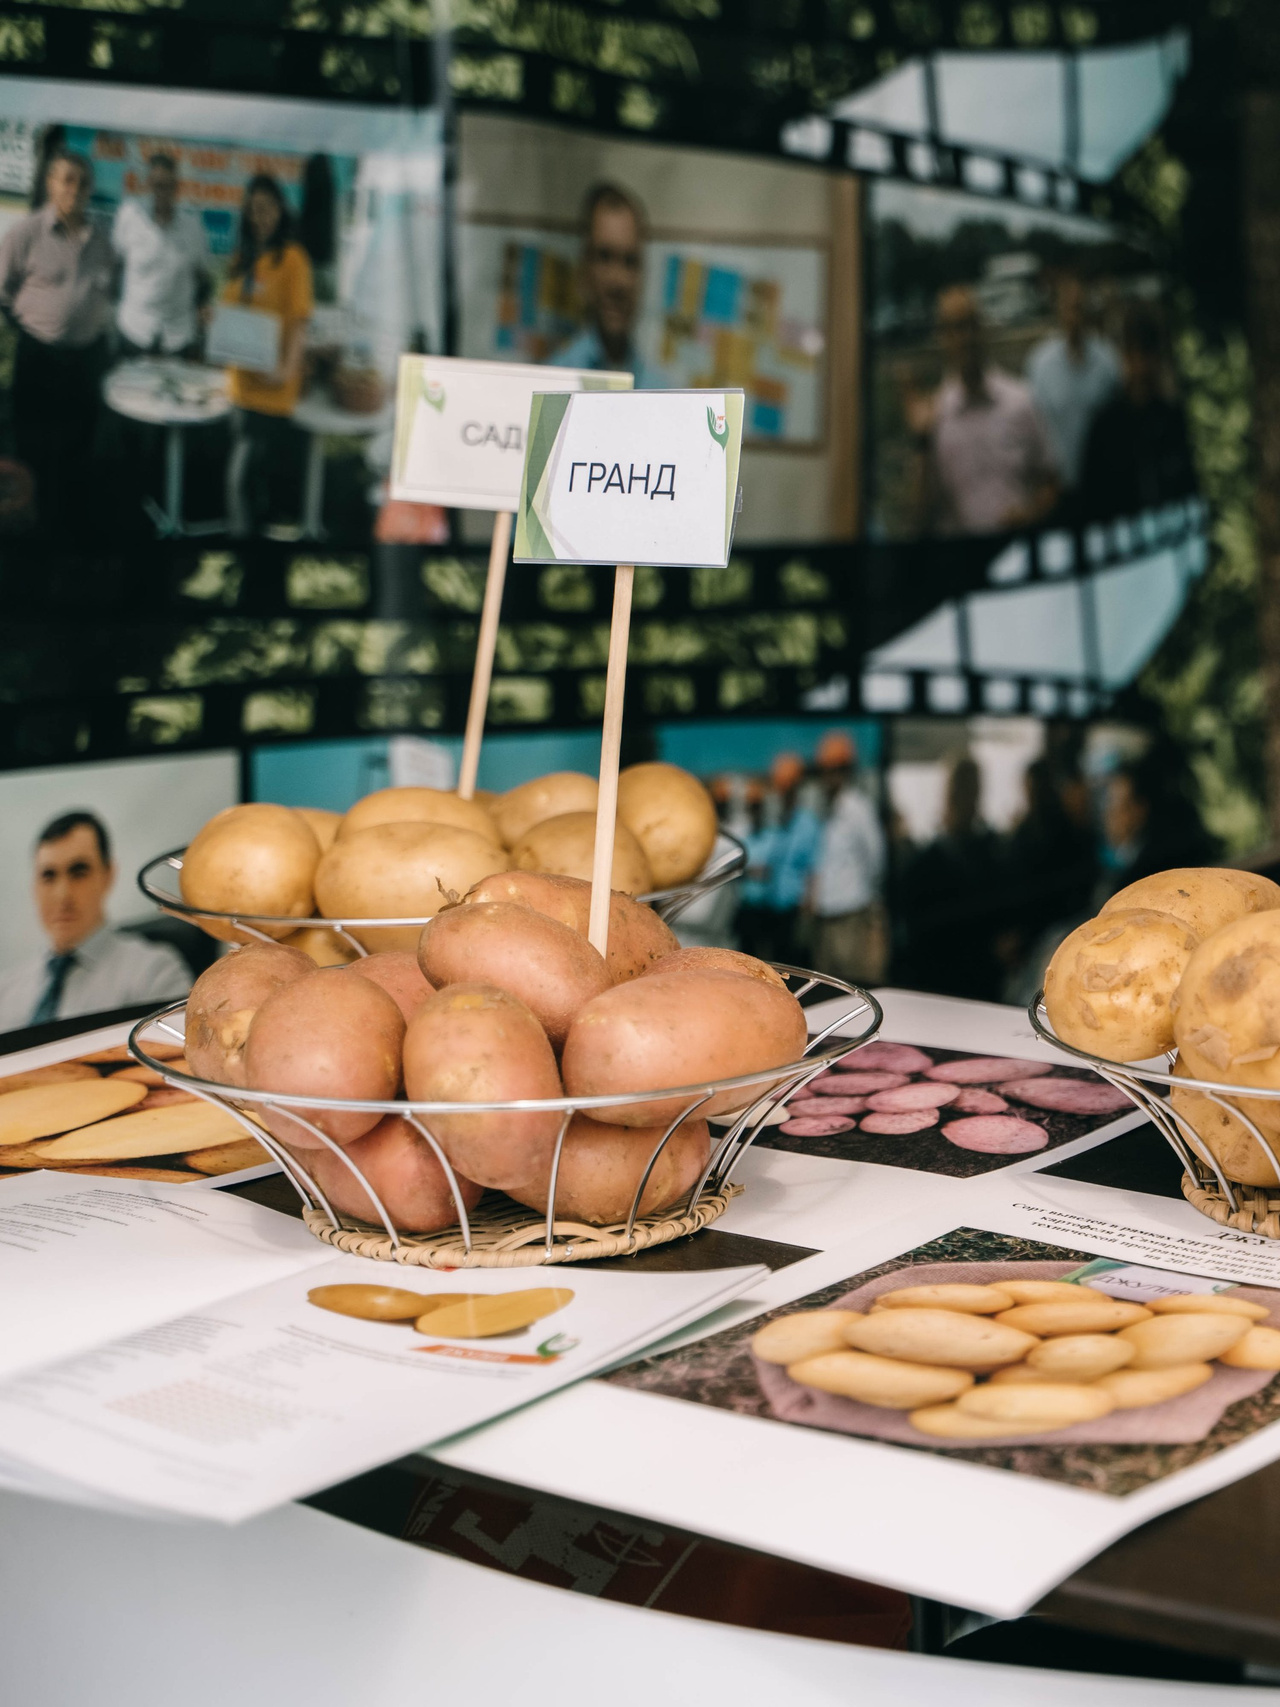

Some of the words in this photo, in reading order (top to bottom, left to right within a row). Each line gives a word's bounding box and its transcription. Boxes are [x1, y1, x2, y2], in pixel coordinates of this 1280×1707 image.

[460, 420, 524, 453] САД
[568, 462, 677, 501] ГРАНД
[1012, 1203, 1047, 1212] Сорт
[1048, 1210, 1107, 1225] выведен
[1119, 1226, 1174, 1241] рамках
[1031, 1221, 1118, 1243] технической
[1120, 1241, 1203, 1261] программы
[1040, 1216, 1114, 1235] картофеля
[1129, 1235, 1209, 1255] Самарской
[1093, 1275, 1192, 1296] ДЖУЛИЯ
